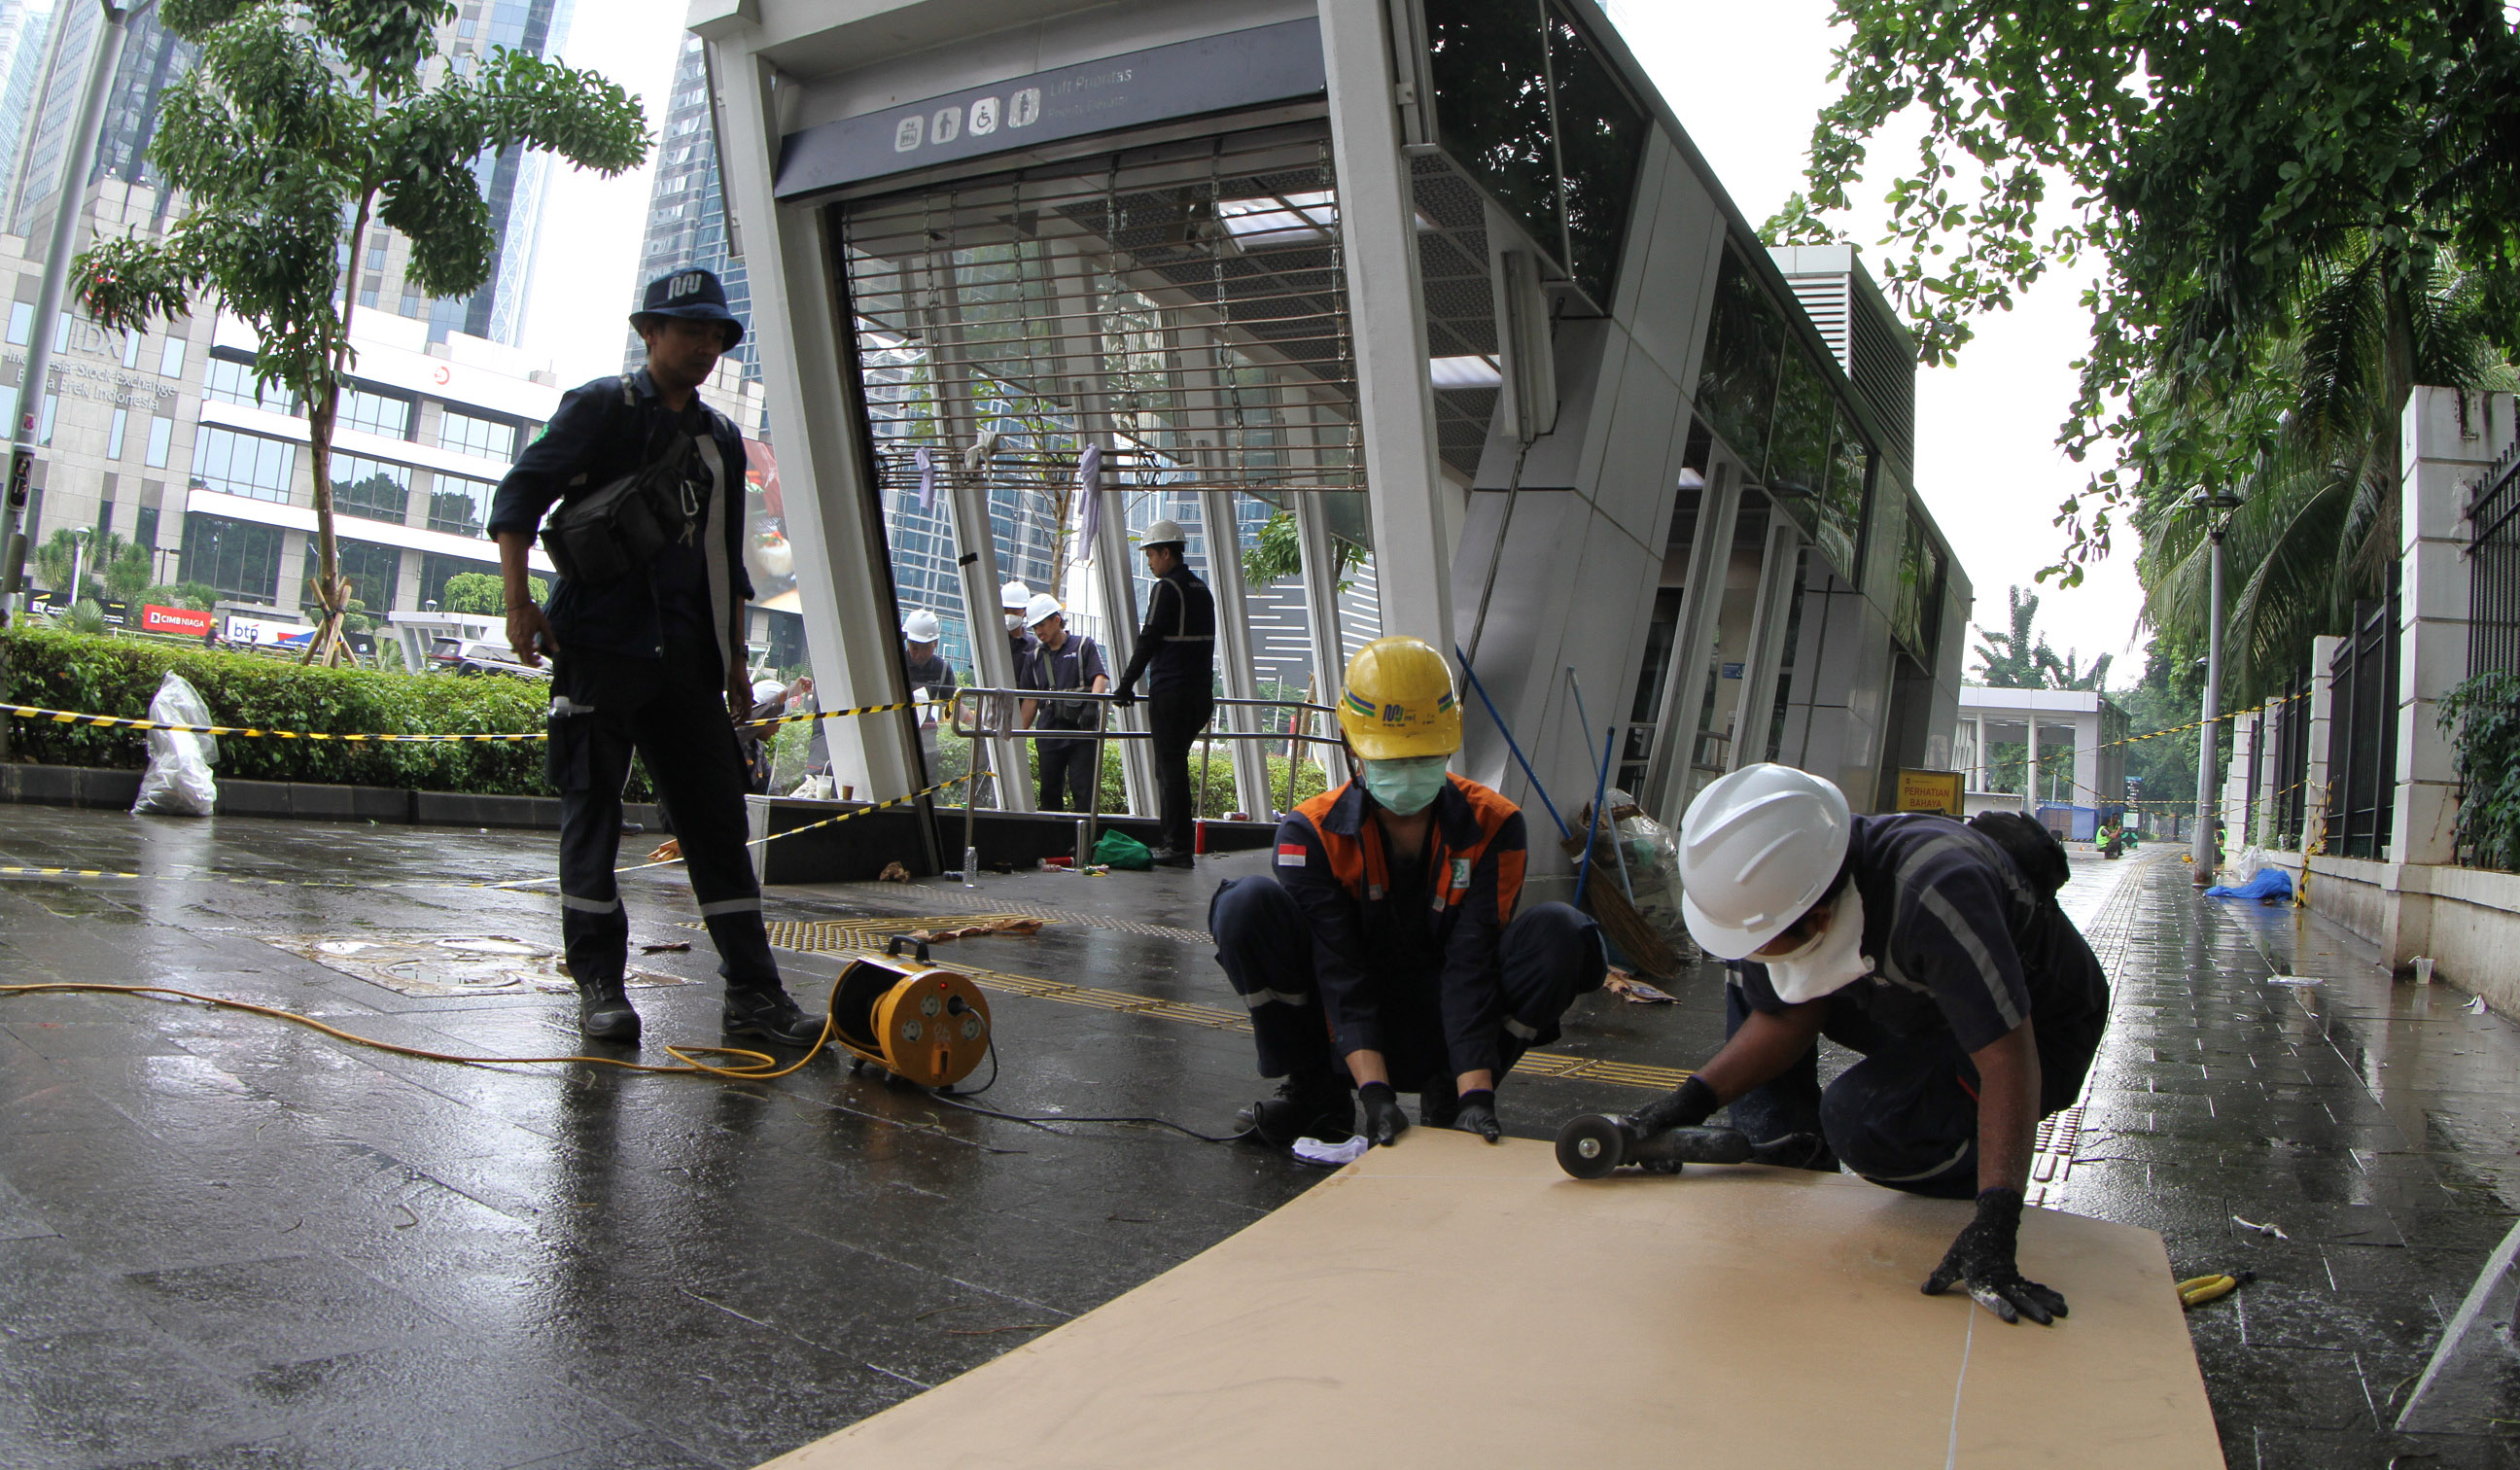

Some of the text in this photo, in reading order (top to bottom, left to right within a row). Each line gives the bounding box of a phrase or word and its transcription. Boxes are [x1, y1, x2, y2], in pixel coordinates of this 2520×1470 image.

[71, 322, 120, 360] IDX
[77, 362, 113, 383] Stock
[115, 370, 176, 398] Exchange
[94, 384, 159, 411] Indonesia
[31, 601, 48, 612] EY
[160, 615, 205, 629] CIMB NIAGA
[1905, 787, 1950, 797] PERHATIAN
[1909, 798, 1942, 807] BAHAYA
